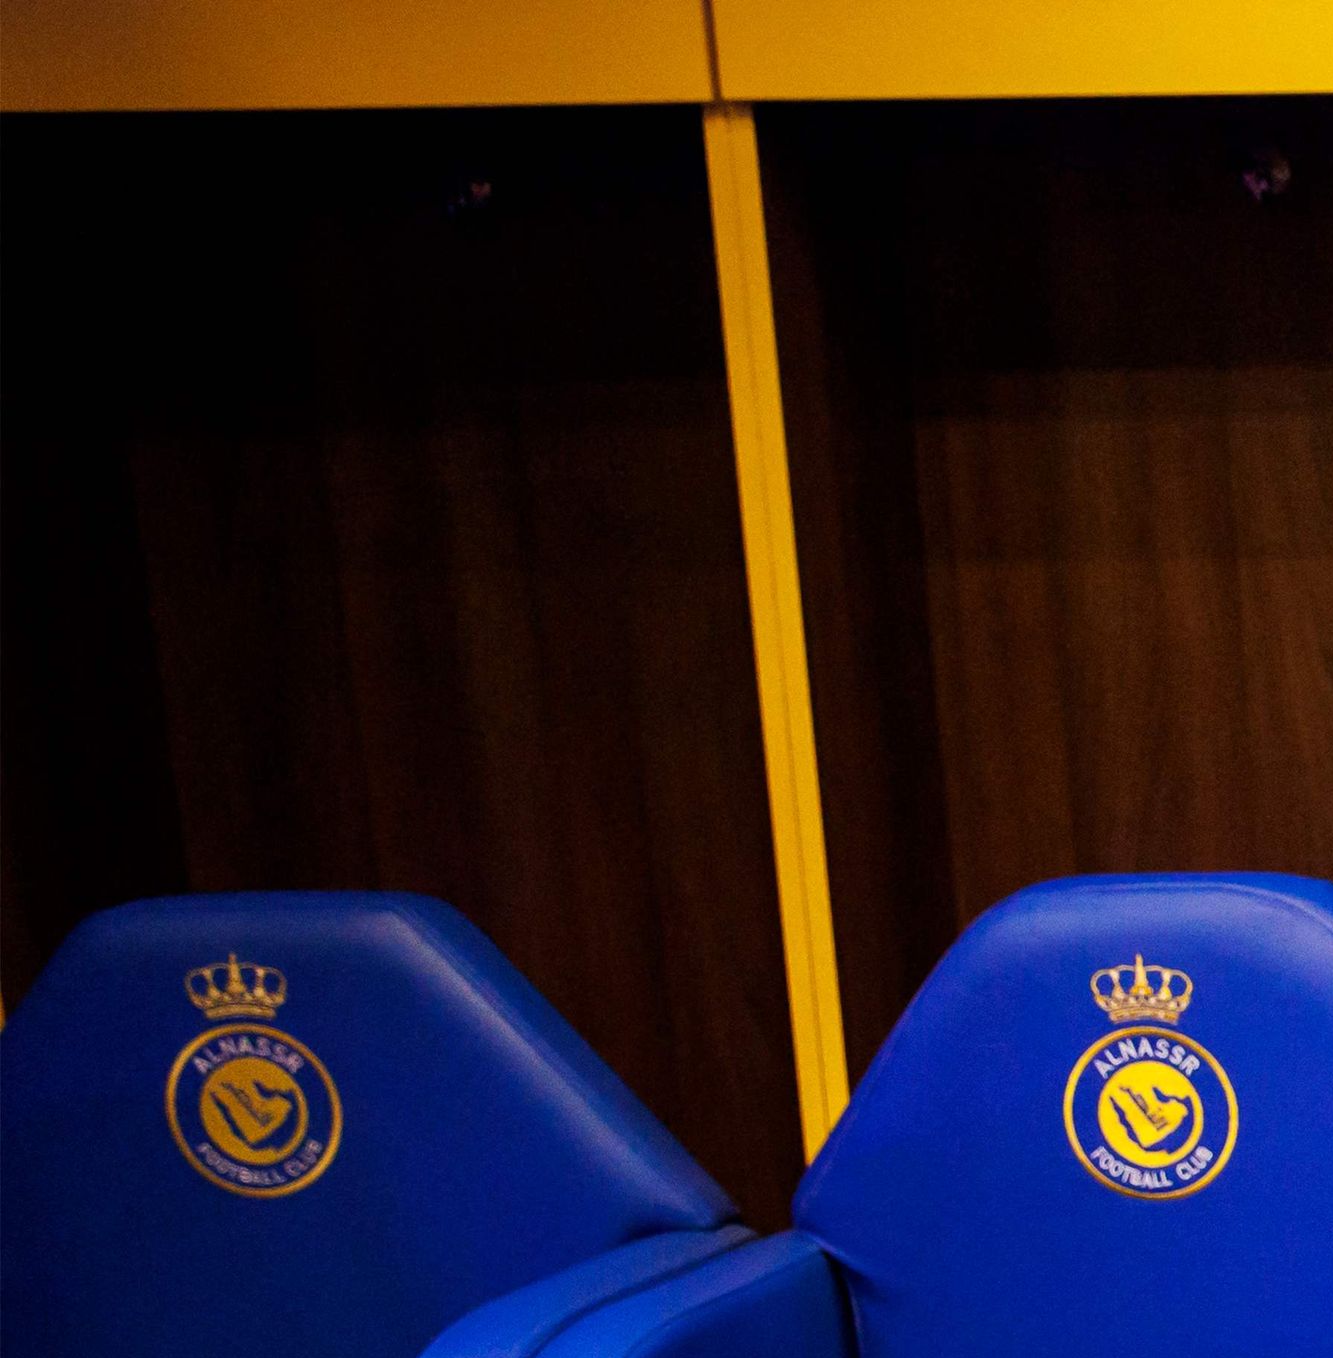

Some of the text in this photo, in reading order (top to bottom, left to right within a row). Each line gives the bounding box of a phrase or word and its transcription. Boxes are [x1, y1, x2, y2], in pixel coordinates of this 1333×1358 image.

[1094, 1037, 1200, 1079] ALNASSR
[1091, 1146, 1214, 1188] FOOTBALL CLUB
